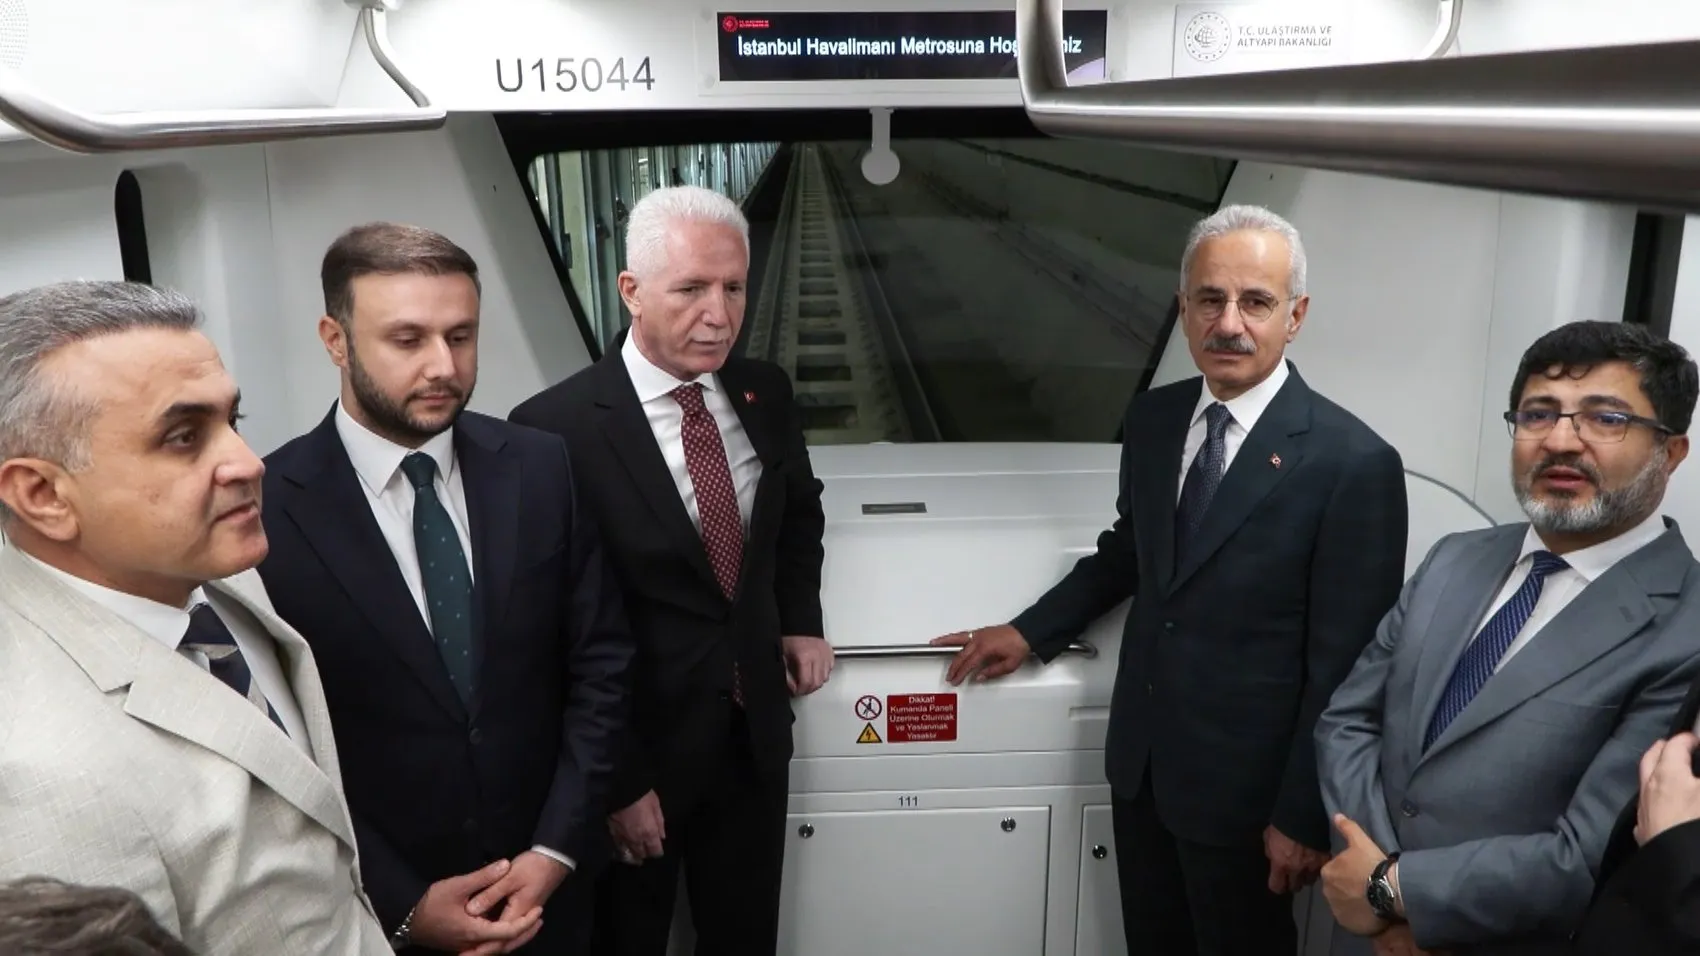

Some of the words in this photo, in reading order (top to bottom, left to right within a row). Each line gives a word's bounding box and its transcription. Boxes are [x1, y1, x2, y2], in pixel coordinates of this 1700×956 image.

[1257, 25, 1317, 36] ULAŞTIRMA
[738, 34, 801, 56] İstanbul
[806, 37, 896, 56] Havalimanı
[901, 36, 985, 55] Metrosuna
[1237, 37, 1277, 47] ALTYAPI
[496, 55, 656, 93] U15044
[908, 695, 936, 704] Dikkat!
[890, 706, 928, 714] Kumanda
[929, 703, 954, 712] Paneli
[921, 713, 955, 721] Oturmak
[907, 723, 949, 731] Yaslanmak
[898, 795, 919, 807] 111
